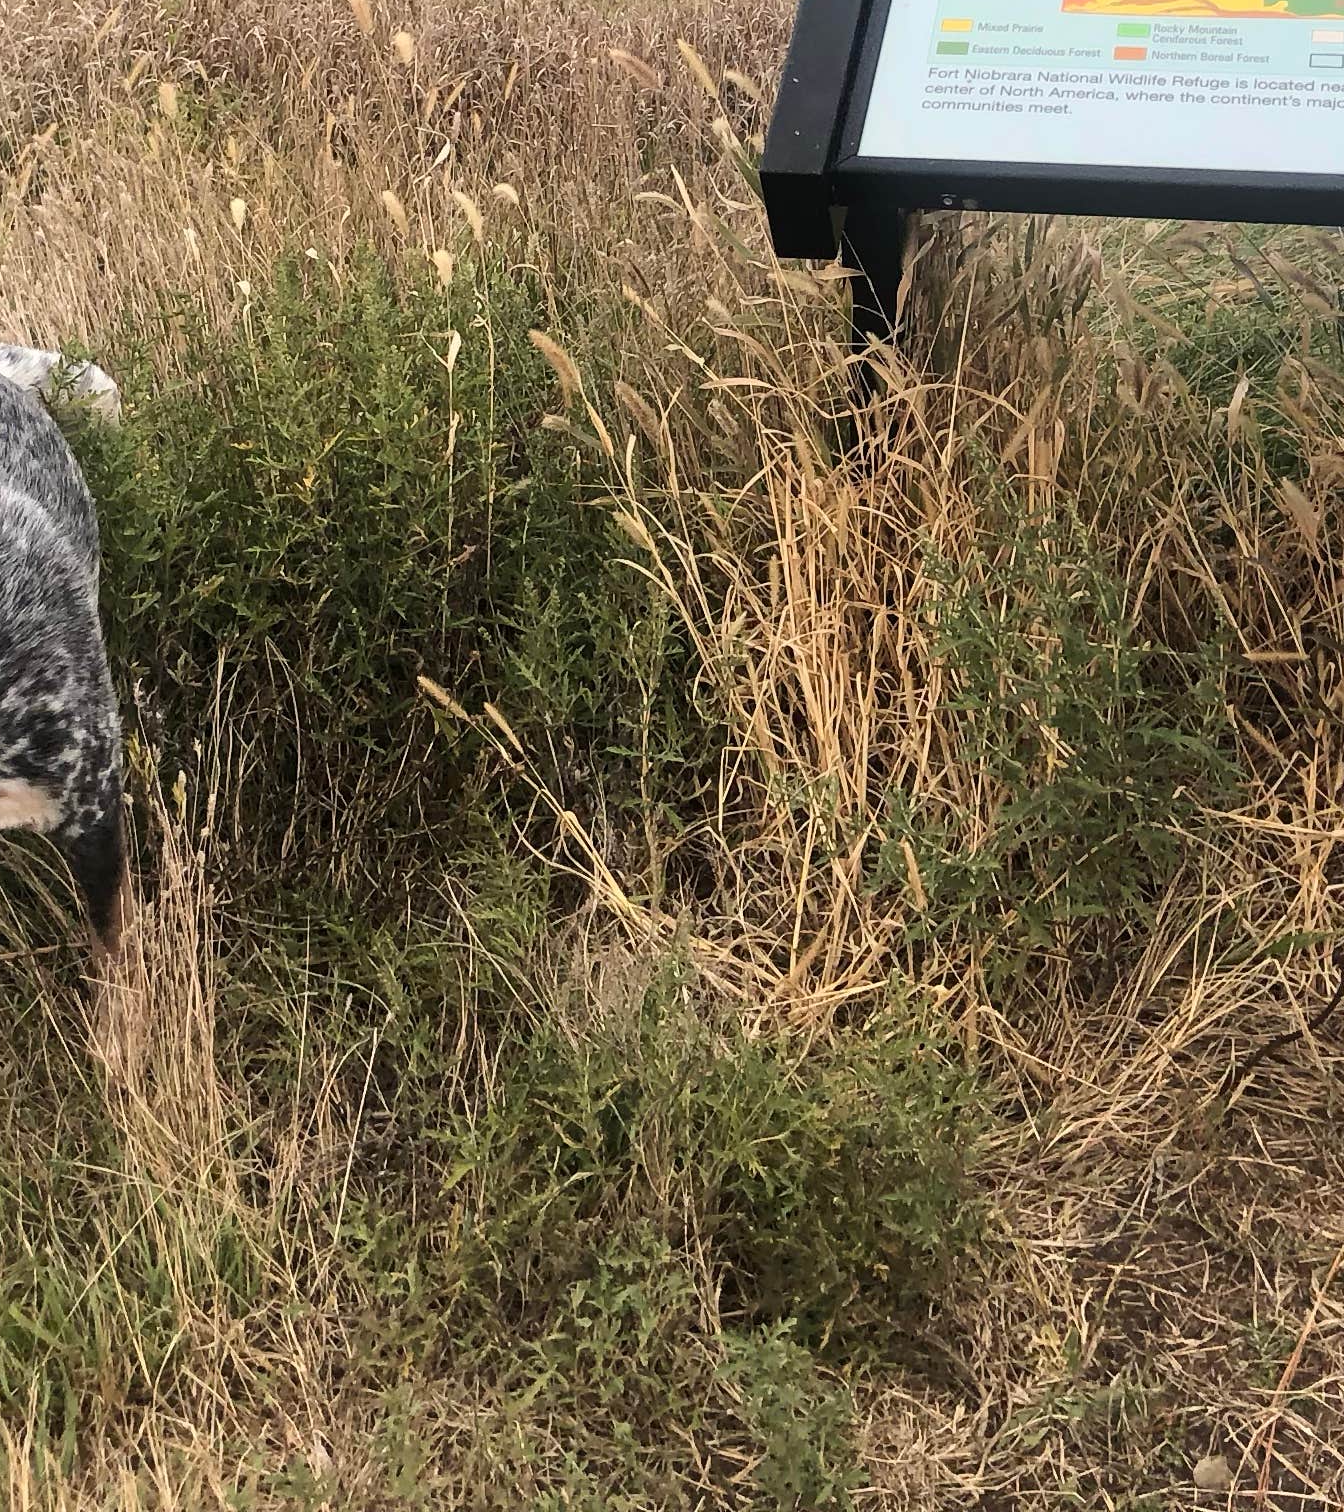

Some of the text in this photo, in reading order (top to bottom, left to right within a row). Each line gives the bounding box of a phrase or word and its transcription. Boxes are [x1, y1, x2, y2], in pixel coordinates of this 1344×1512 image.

[977, 21, 1044, 33] Mixed Prairie
[1154, 23, 1238, 35] Rocky Mountain
[1152, 34, 1243, 46] Coniferous Forest
[971, 44, 1103, 58] Eastern Deciduous Forest
[1151, 51, 1270, 64] Northern Boreal Forest
[928, 67, 960, 79] Fort
[964, 68, 1032, 81] Niobrara
[1037, 71, 1103, 84] National
[1108, 73, 1167, 86] Wildlife
[1171, 75, 1230, 89] Refuge
[1235, 77, 1249, 89] is
[1253, 77, 1315, 91] located
[924, 84, 975, 95] center
[978, 85, 996, 96] of
[999, 85, 1044, 97] North
[1047, 87, 1119, 102] America,
[1125, 90, 1175, 102] where
[1179, 91, 1206, 103] the
[1210, 93, 1301, 107] continent's
[921, 99, 1072, 114] communities meet.
